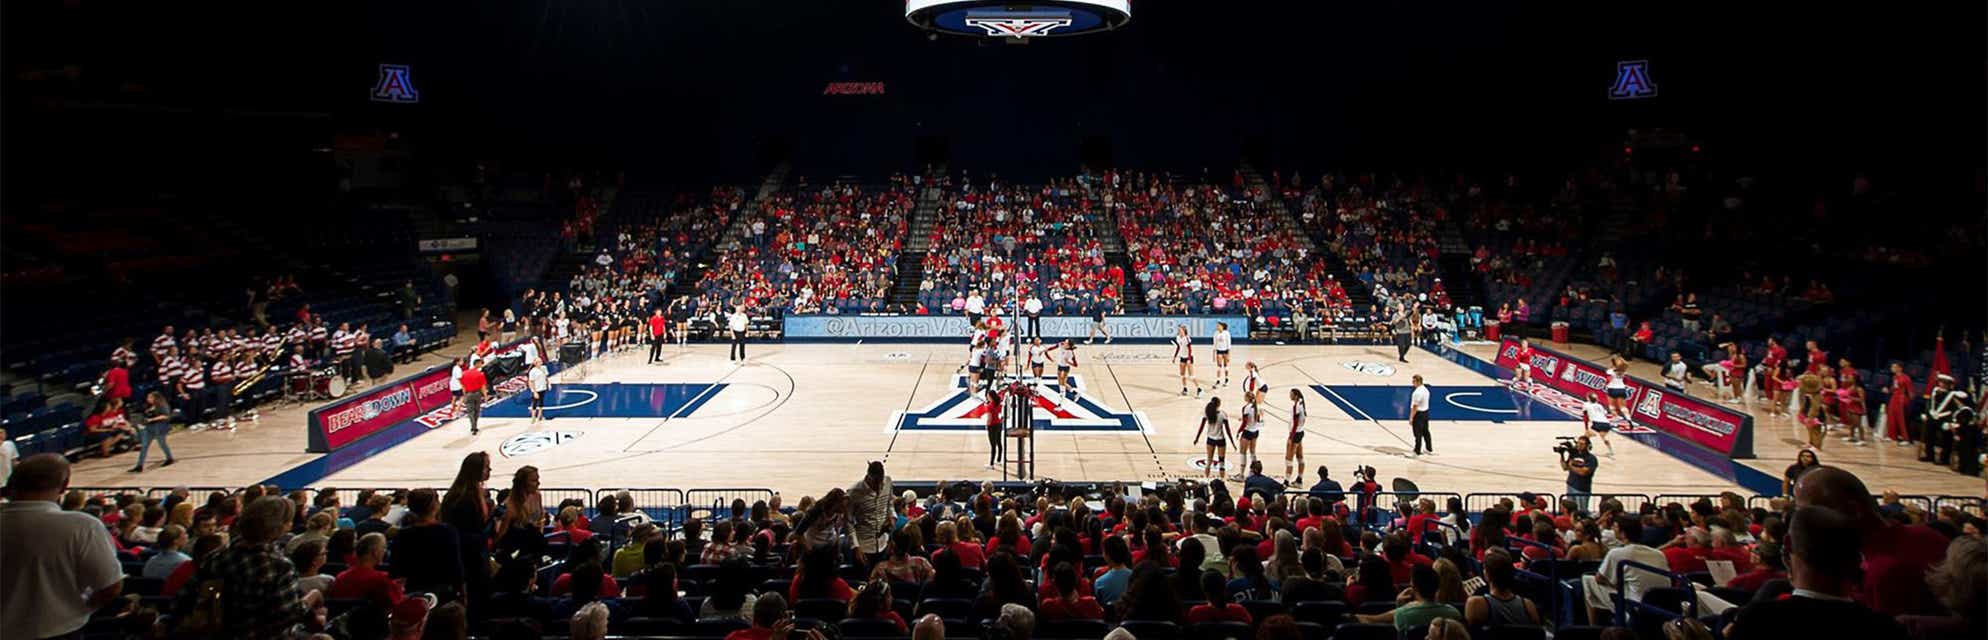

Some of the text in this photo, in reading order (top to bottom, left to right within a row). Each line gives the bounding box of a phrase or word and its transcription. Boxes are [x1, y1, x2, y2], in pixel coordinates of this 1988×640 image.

[370, 63, 418, 103] A
[1608, 60, 1657, 100] A
[824, 317, 975, 336] @ArizonaVBa
[371, 387, 411, 415] DOWN
[1637, 389, 1662, 419] A
